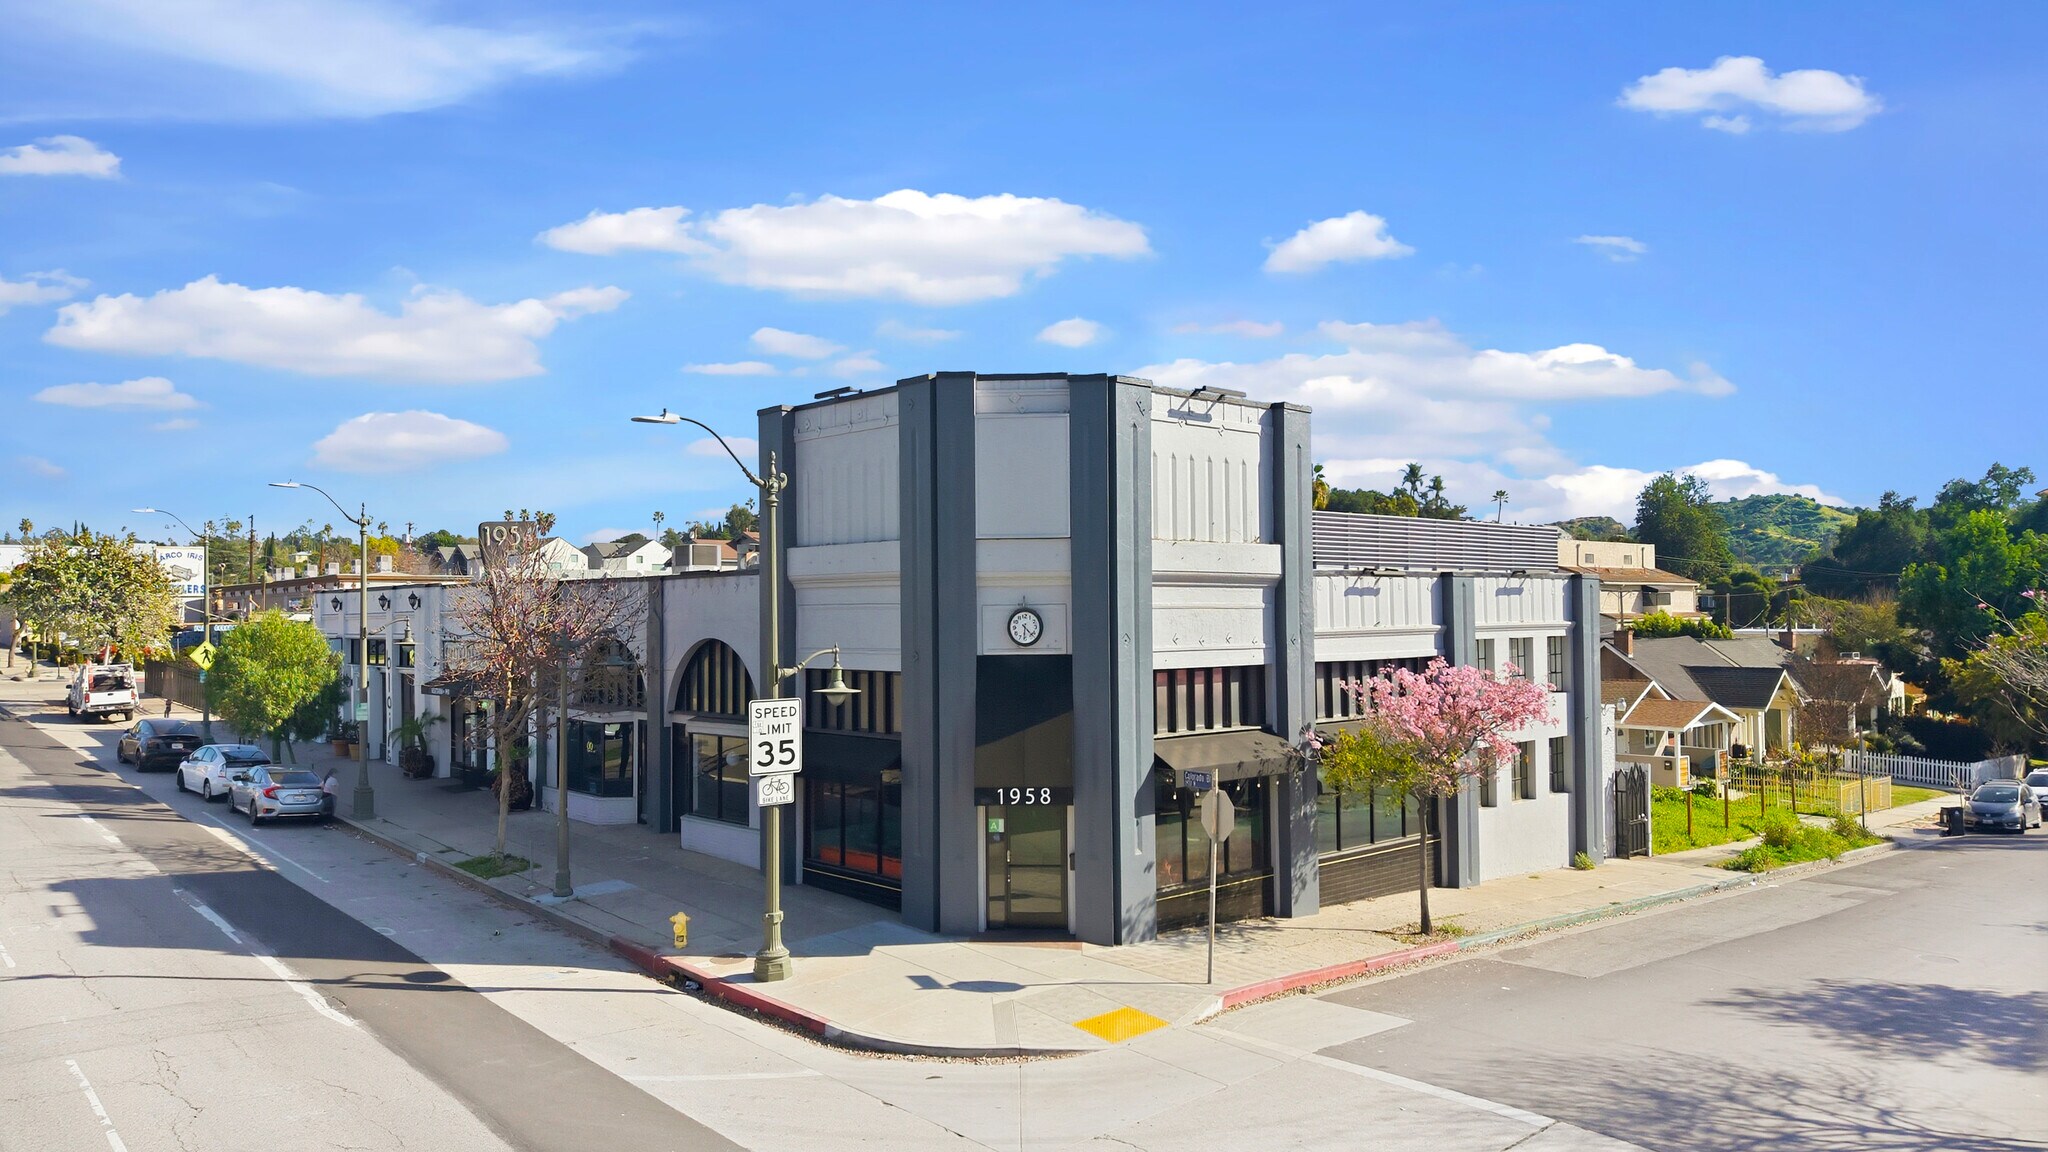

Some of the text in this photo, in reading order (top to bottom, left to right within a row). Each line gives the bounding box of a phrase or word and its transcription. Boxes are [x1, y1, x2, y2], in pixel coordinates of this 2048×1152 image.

[159, 551, 203, 562] ARCO IRIS
[755, 706, 797, 719] SPEED
[757, 739, 796, 767] 35
[1184, 771, 1206, 783] Colorado
[997, 787, 1051, 805] 1958
[990, 821, 998, 830] A
